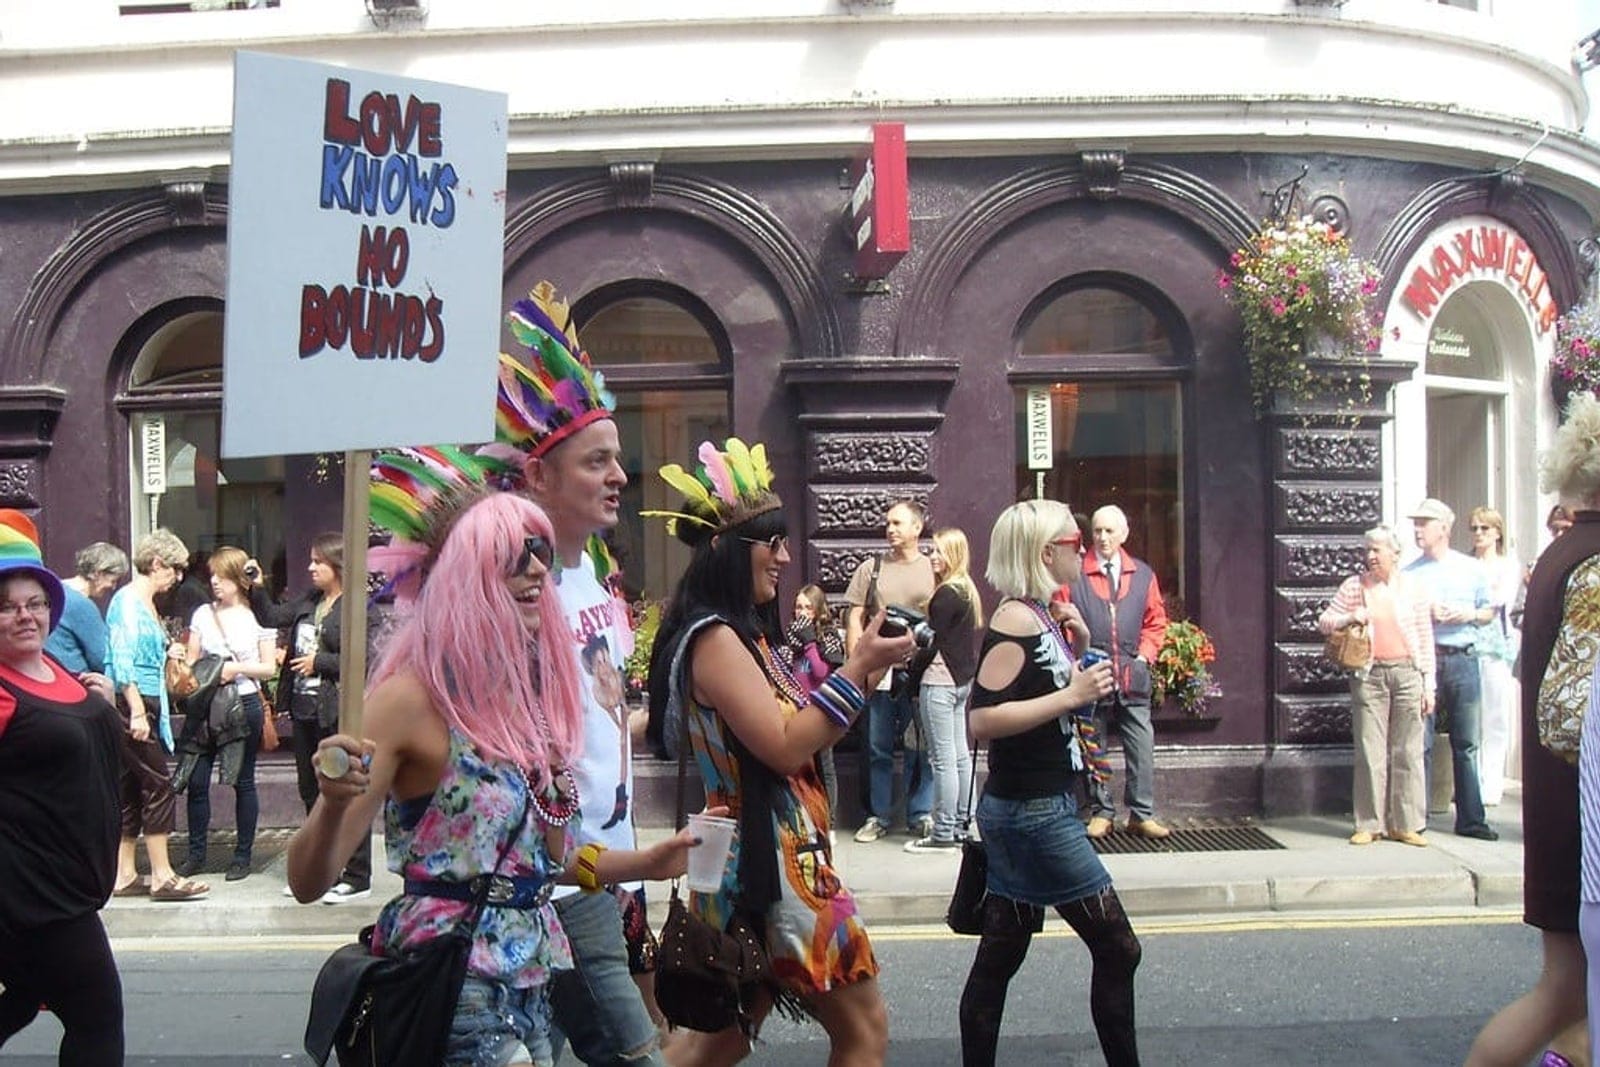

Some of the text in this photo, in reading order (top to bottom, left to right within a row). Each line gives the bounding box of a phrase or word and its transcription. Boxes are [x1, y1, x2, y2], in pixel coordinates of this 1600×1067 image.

[325, 78, 442, 157] LOVE
[320, 143, 459, 228] KNOWS
[357, 224, 410, 288] NO
[1404, 227, 1557, 333] MAXWELLS
[299, 284, 444, 363] BOUNDS
[146, 417, 161, 487] MAXWELLS
[1031, 390, 1048, 461] MAXWELLS
